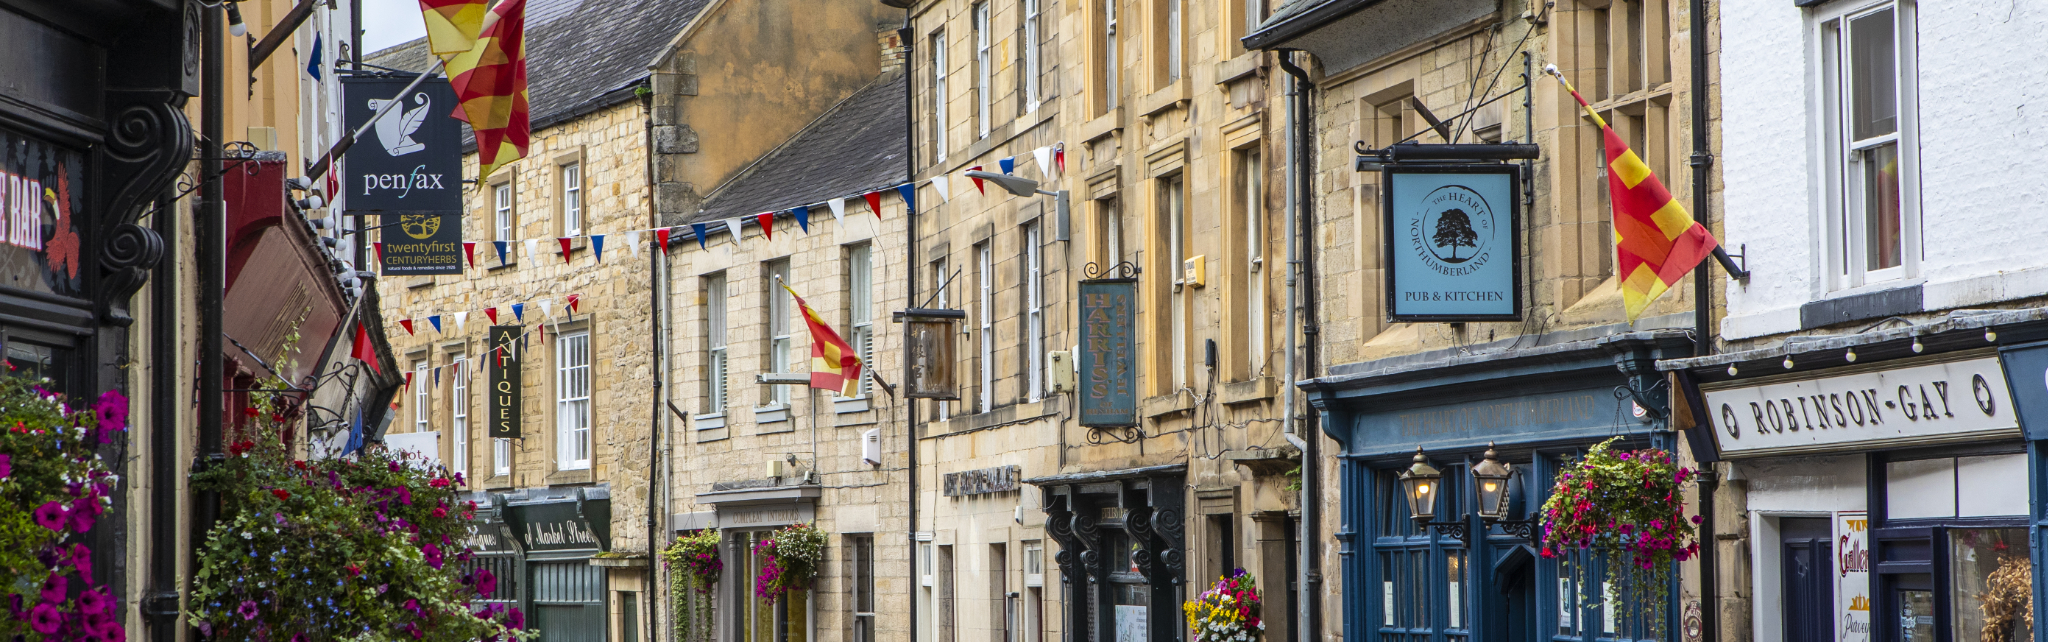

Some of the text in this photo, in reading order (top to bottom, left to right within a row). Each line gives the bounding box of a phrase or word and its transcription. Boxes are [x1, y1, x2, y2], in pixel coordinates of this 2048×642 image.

[363, 164, 444, 199] penfax
[10, 173, 42, 252] BAR
[1432, 192, 1489, 230] THE HEART OF
[387, 240, 456, 256] twentyfirst
[1410, 217, 1490, 277] NORTHUMBERLAND
[1405, 291, 1504, 302] PUB & KITCHEN
[1116, 294, 1130, 398] JEWELLERS
[497, 330, 512, 433] ANTIQUES
[1399, 394, 1595, 437] THE HEART OF NORTHUMBERLAND
[1750, 380, 1954, 435] ROBINSON-GAY
[525, 522, 534, 550] of
[536, 521, 566, 546] Market
[732, 508, 799, 524] COMPLEAT INTERIORS
